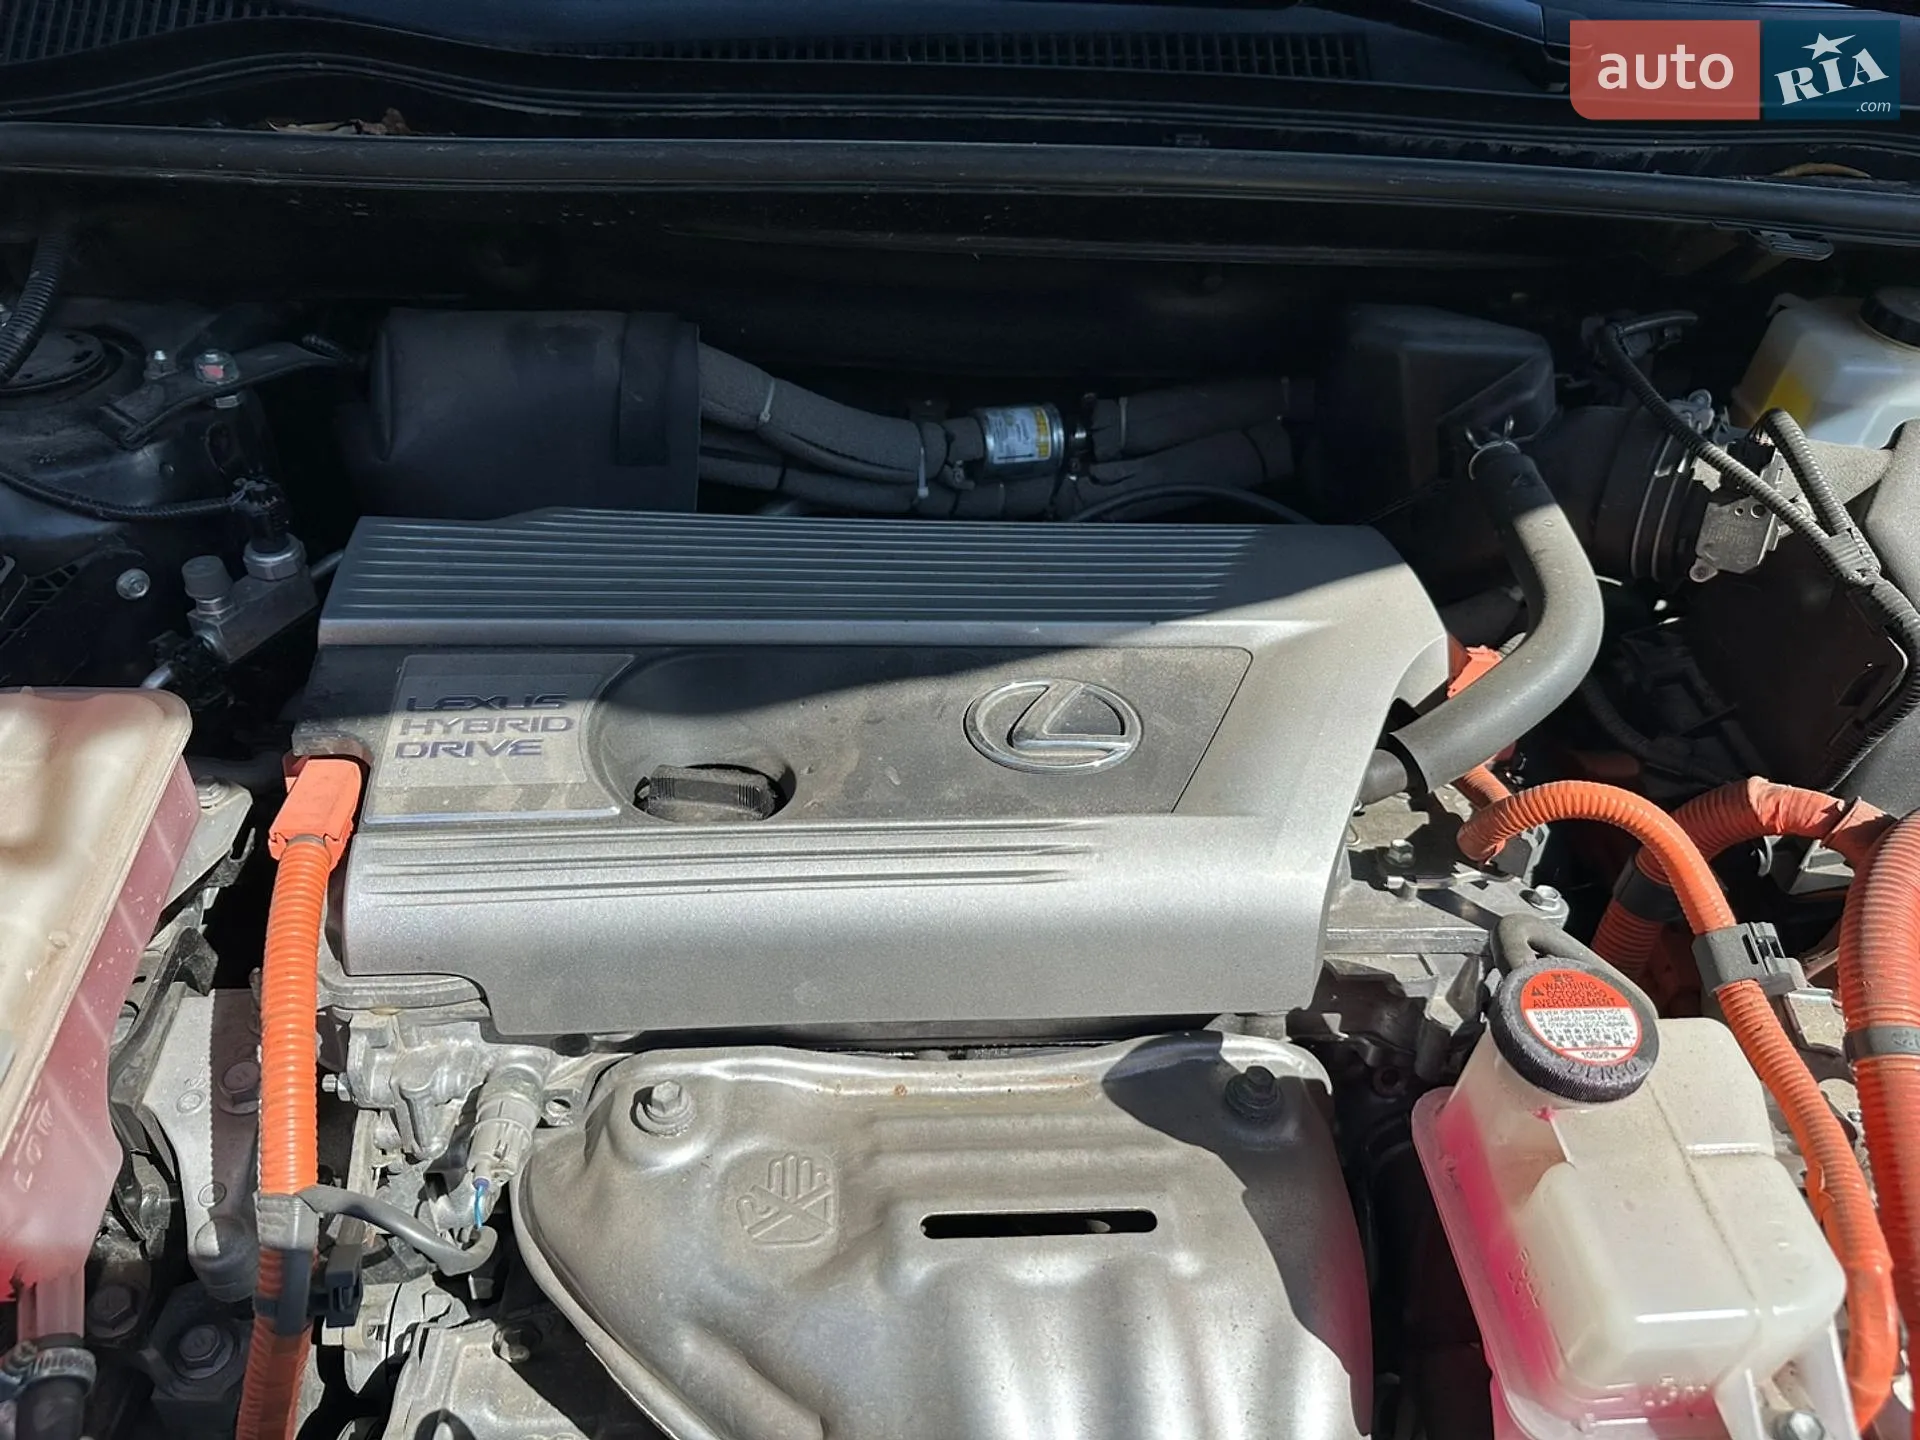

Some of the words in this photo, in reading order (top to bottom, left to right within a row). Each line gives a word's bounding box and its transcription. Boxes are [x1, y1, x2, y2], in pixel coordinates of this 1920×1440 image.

[405, 693, 569, 711] LEXUS
[400, 716, 573, 735] HYBRID
[394, 738, 545, 759] DRIVE
[1543, 981, 1598, 991] WARNING
[1533, 997, 1617, 1008] AVERTISSEMENT
